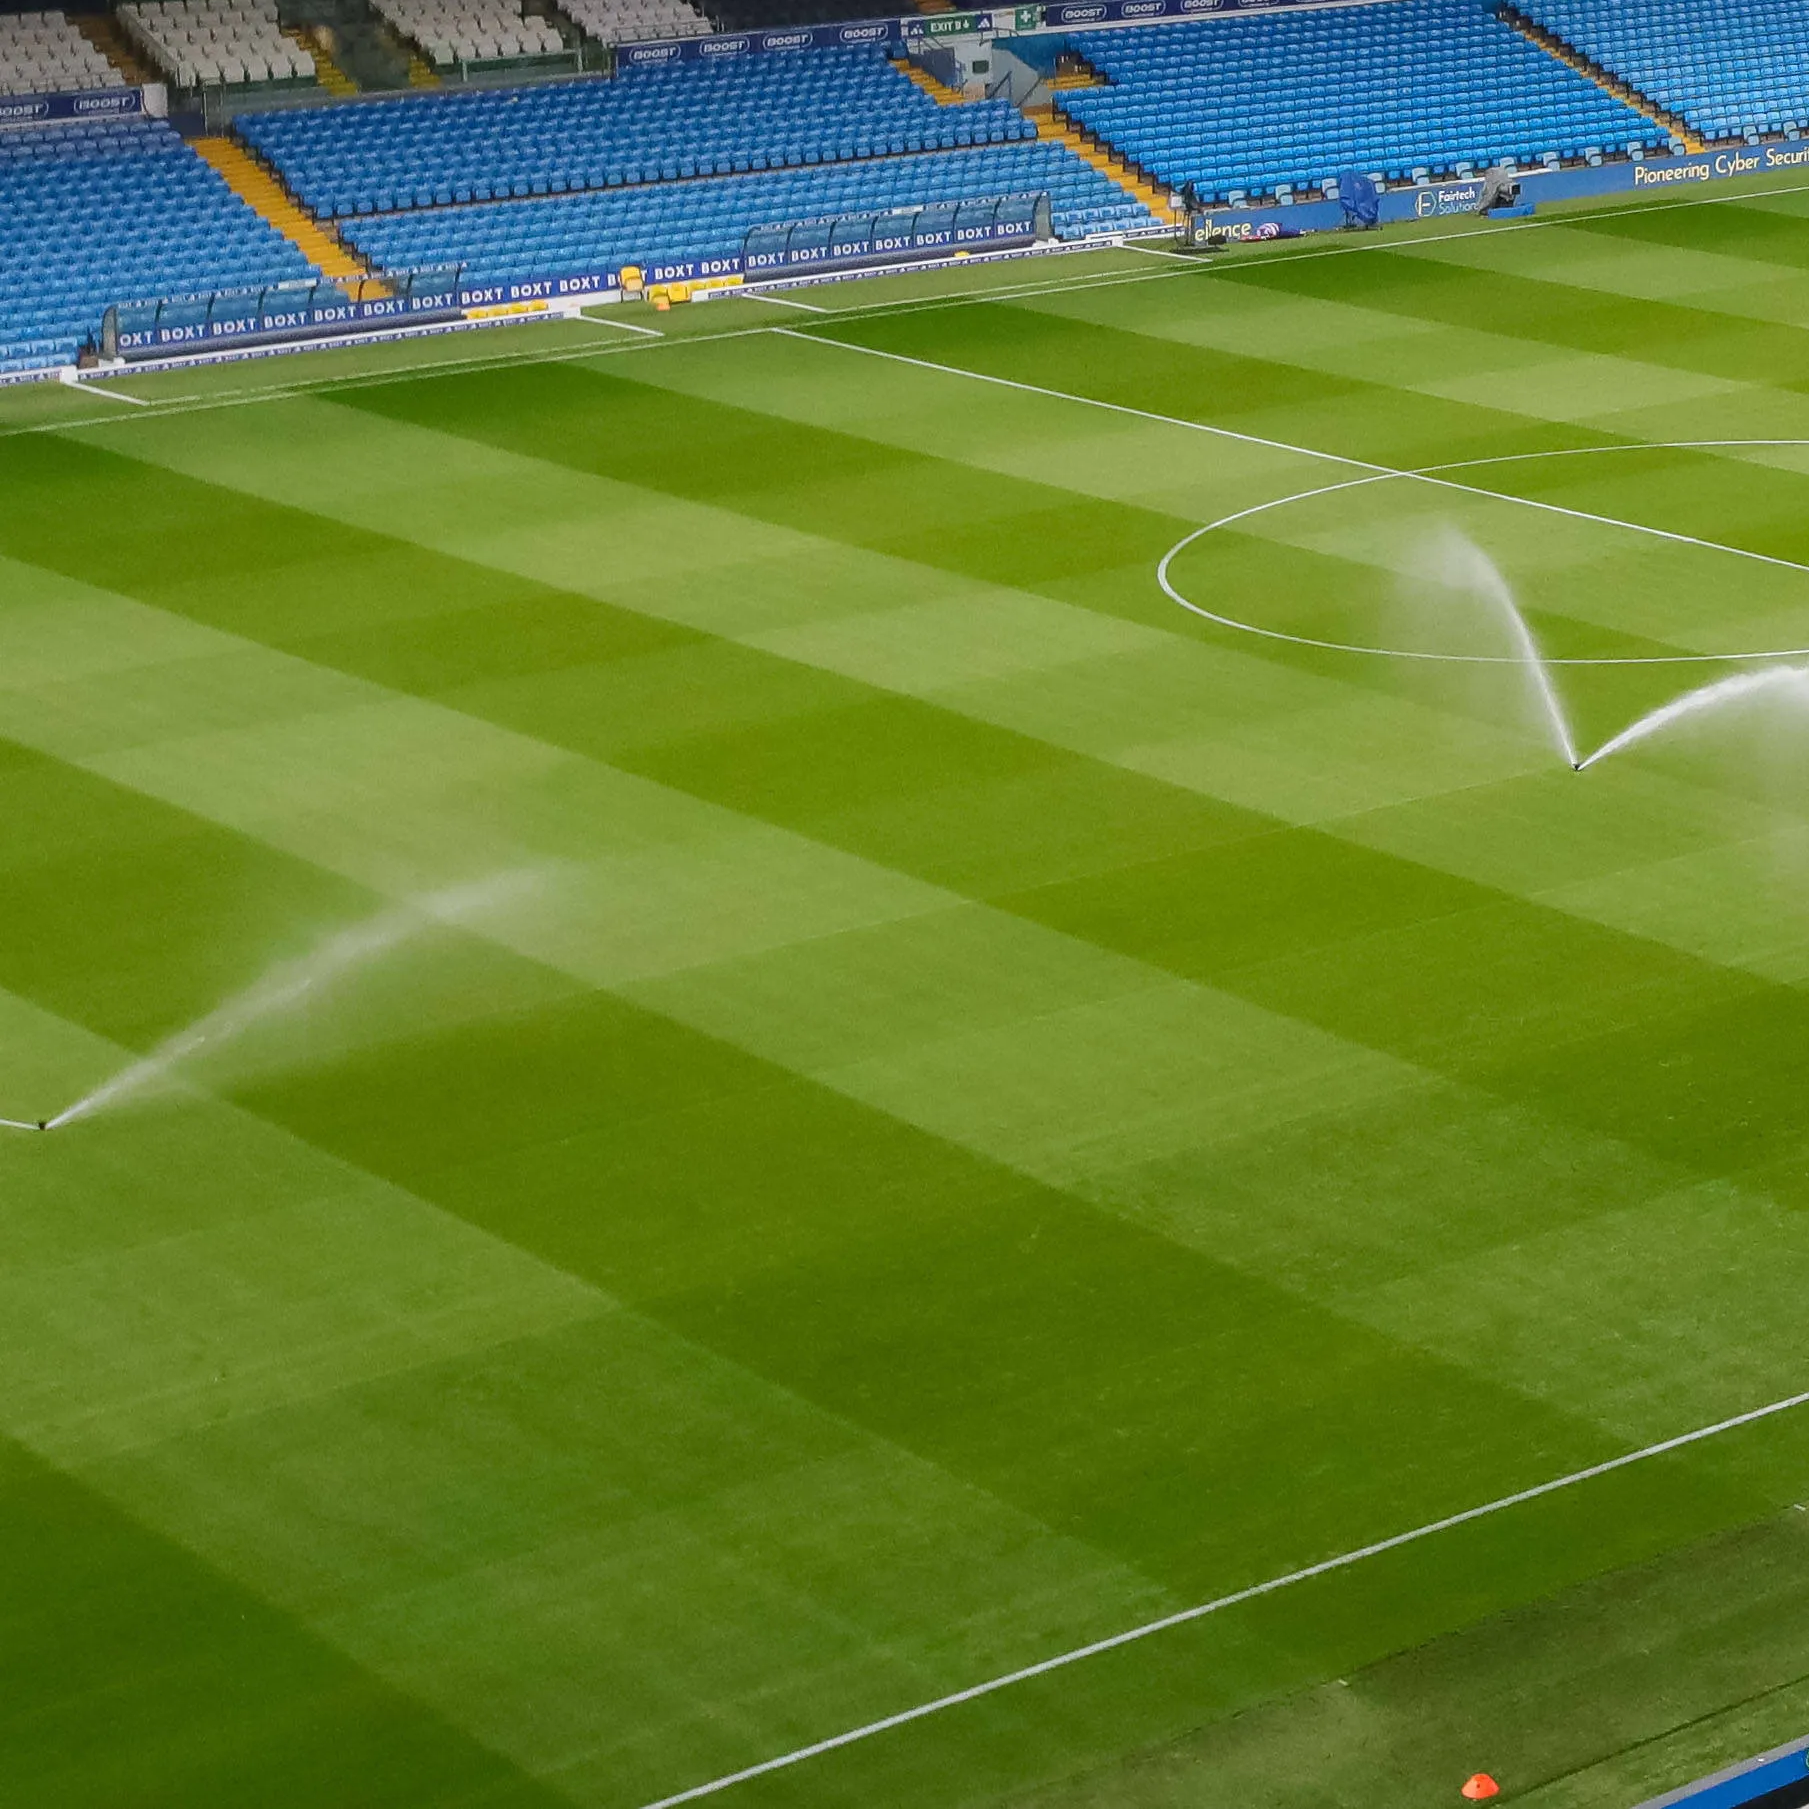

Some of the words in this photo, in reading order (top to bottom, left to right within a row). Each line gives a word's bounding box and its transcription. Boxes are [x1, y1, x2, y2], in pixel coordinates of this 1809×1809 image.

[1066, 7, 1103, 19] BOOST
[1126, 3, 1160, 15] BOOST
[845, 27, 884, 41] BOOST
[931, 21, 959, 32] EXIT
[704, 41, 745, 54] BOOST
[768, 35, 808, 48] BOOST
[634, 47, 676, 61] BOOST
[1635, 165, 1709, 185] Pioneering
[1716, 153, 1759, 176] Cyber
[1439, 185, 1475, 202] Fairtech
[958, 227, 991, 240] BOXT
[998, 222, 1030, 235] BOXT
[876, 236, 910, 250] BOXT
[917, 231, 951, 245] BOXT
[792, 247, 828, 262] BOXT
[834, 242, 870, 257] BOXT
[702, 259, 739, 273] BOXT
[749, 252, 784, 267] BOXT
[655, 264, 693, 279] BOXT
[511, 282, 553, 299] BOXT
[560, 276, 600, 293] BOXT
[413, 294, 453, 310] BOXT
[462, 288, 504, 305] BOXT
[315, 306, 357, 324] BOXT
[363, 299, 405, 317] BOXT
[213, 318, 256, 336] BOXT
[264, 312, 307, 330] BOXT
[162, 325, 204, 341] BOXT
